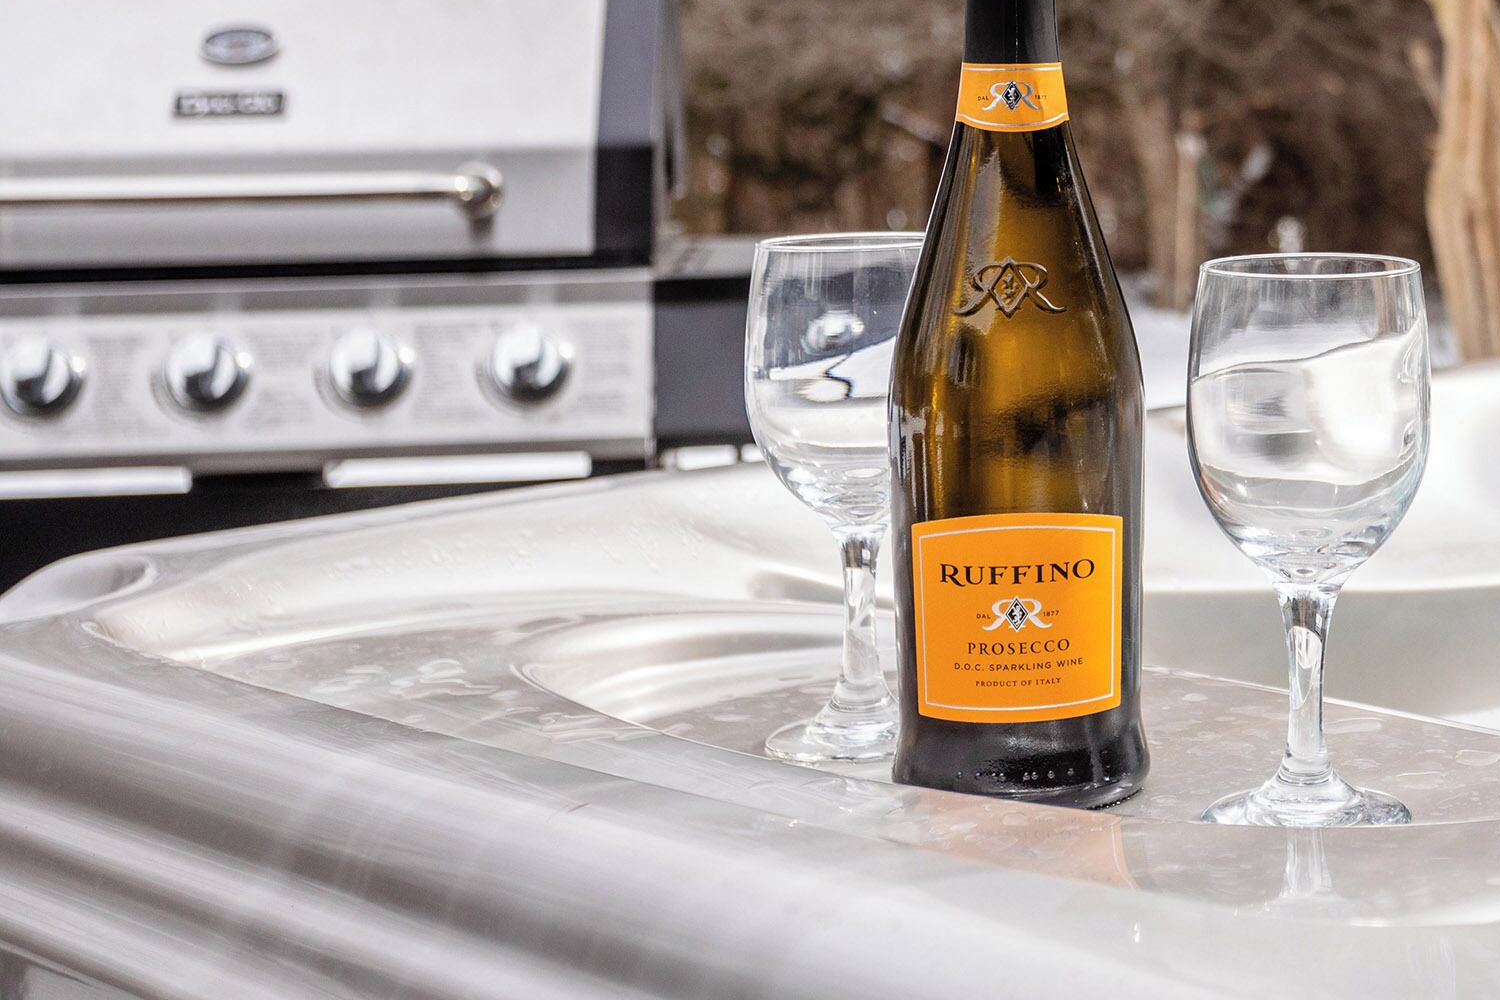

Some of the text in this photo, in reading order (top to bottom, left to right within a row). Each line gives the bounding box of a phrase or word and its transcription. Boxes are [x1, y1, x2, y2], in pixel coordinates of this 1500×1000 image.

[940, 558, 1095, 587] RUFFINO
[967, 638, 1070, 656] PROSECCO
[954, 657, 1083, 671] D.O.C. SPARKLING WINE
[1035, 677, 1062, 686] ITALY
